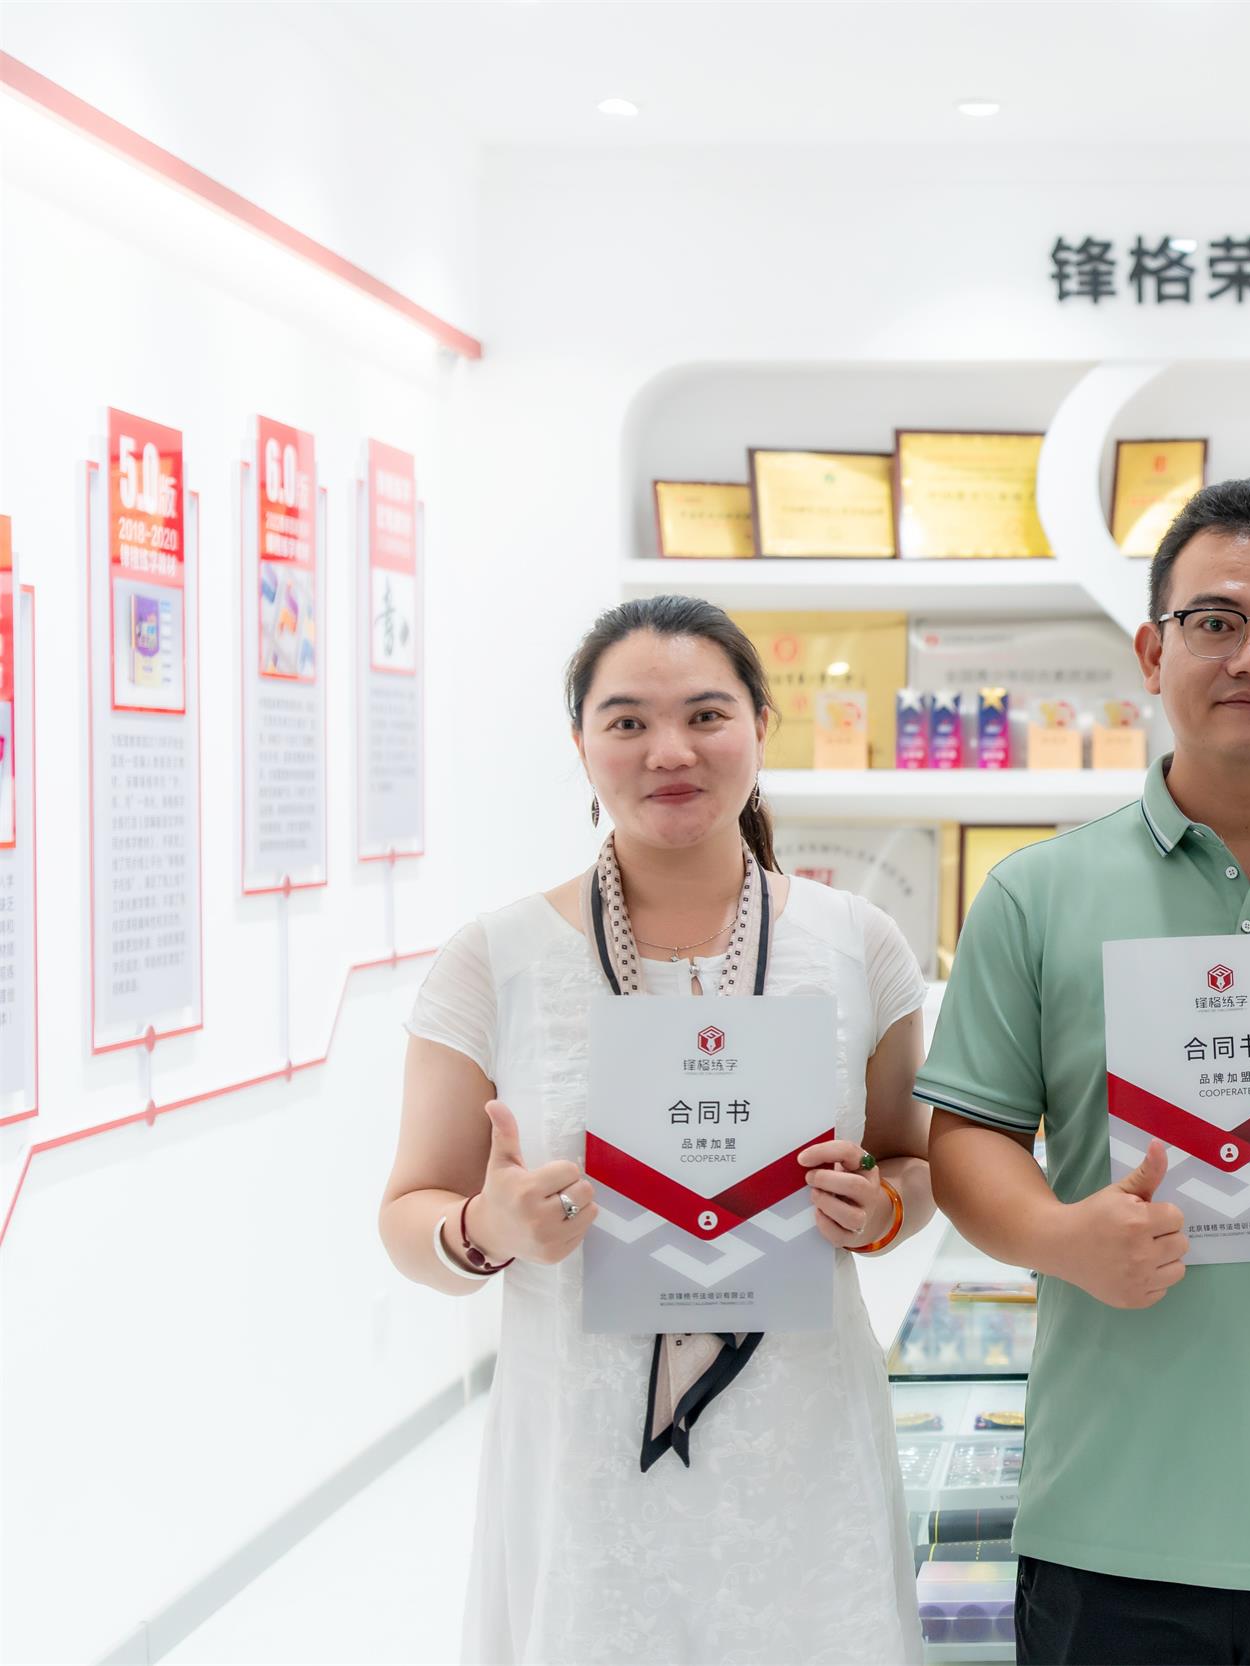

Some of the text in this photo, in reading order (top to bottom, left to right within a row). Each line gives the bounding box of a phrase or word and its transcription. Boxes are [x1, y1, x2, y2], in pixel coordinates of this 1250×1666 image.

[1195, 995, 1248, 1009] 锋格练字
[683, 1059, 738, 1072] 锋格练字
[668, 1100, 751, 1125] 合同书
[681, 1138, 736, 1150] 品牌加盟
[680, 1154, 737, 1163] COOPERATE
